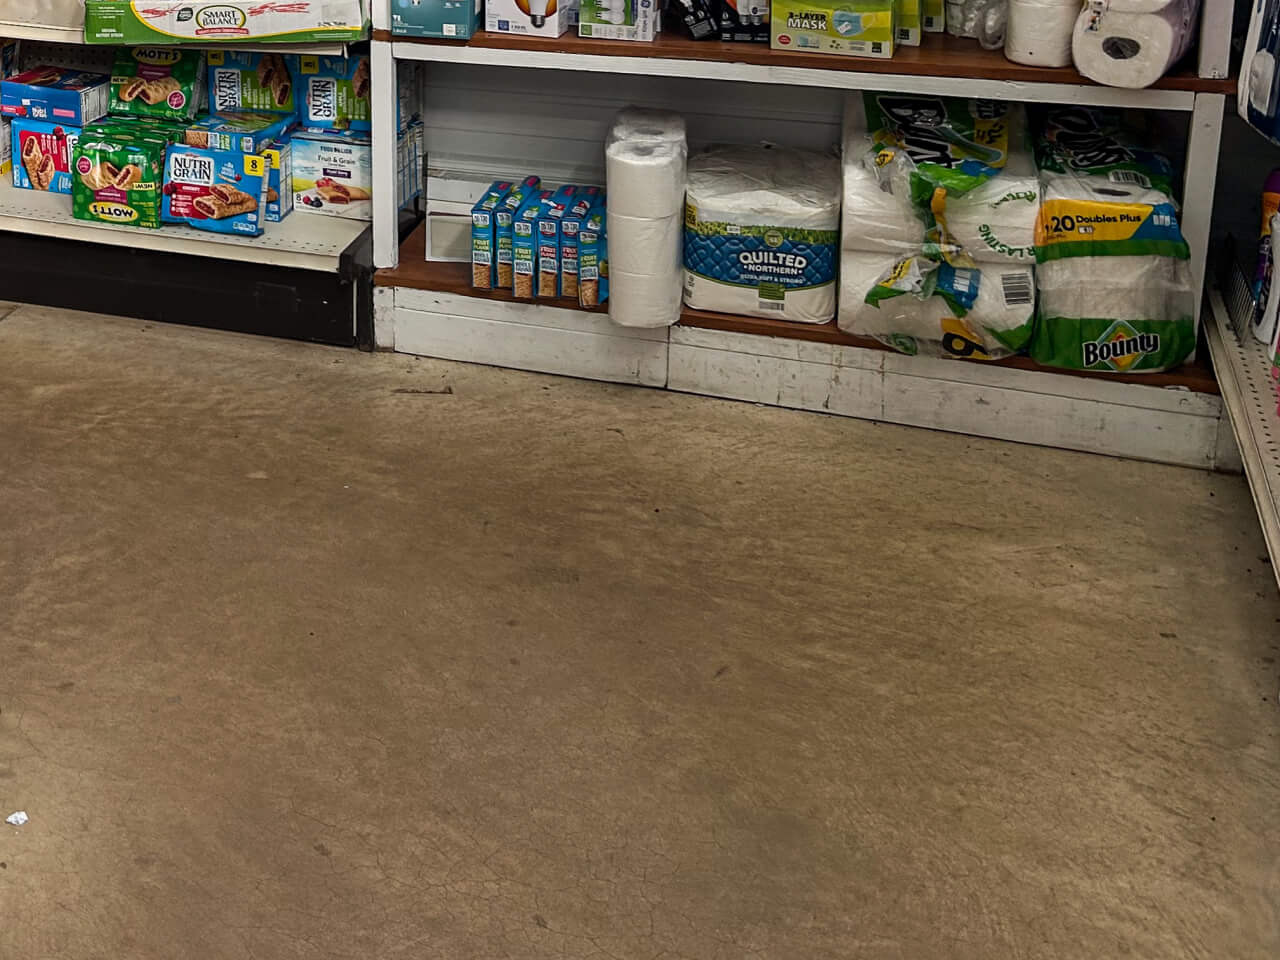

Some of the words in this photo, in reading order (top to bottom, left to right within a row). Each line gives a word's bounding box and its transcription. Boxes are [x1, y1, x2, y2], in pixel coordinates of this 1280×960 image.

[203, 10, 236, 19] SMART
[202, 17, 240, 26] BALANCE
[786, 18, 828, 31] MASK
[173, 156, 213, 170] NUTRI
[250, 158, 258, 169] 8
[173, 167, 212, 181] GRAIN
[1076, 214, 1118, 225] Doubles
[1119, 213, 1142, 223] Plus
[739, 251, 808, 269] QUILTED
[1082, 331, 1161, 368] Bounty
